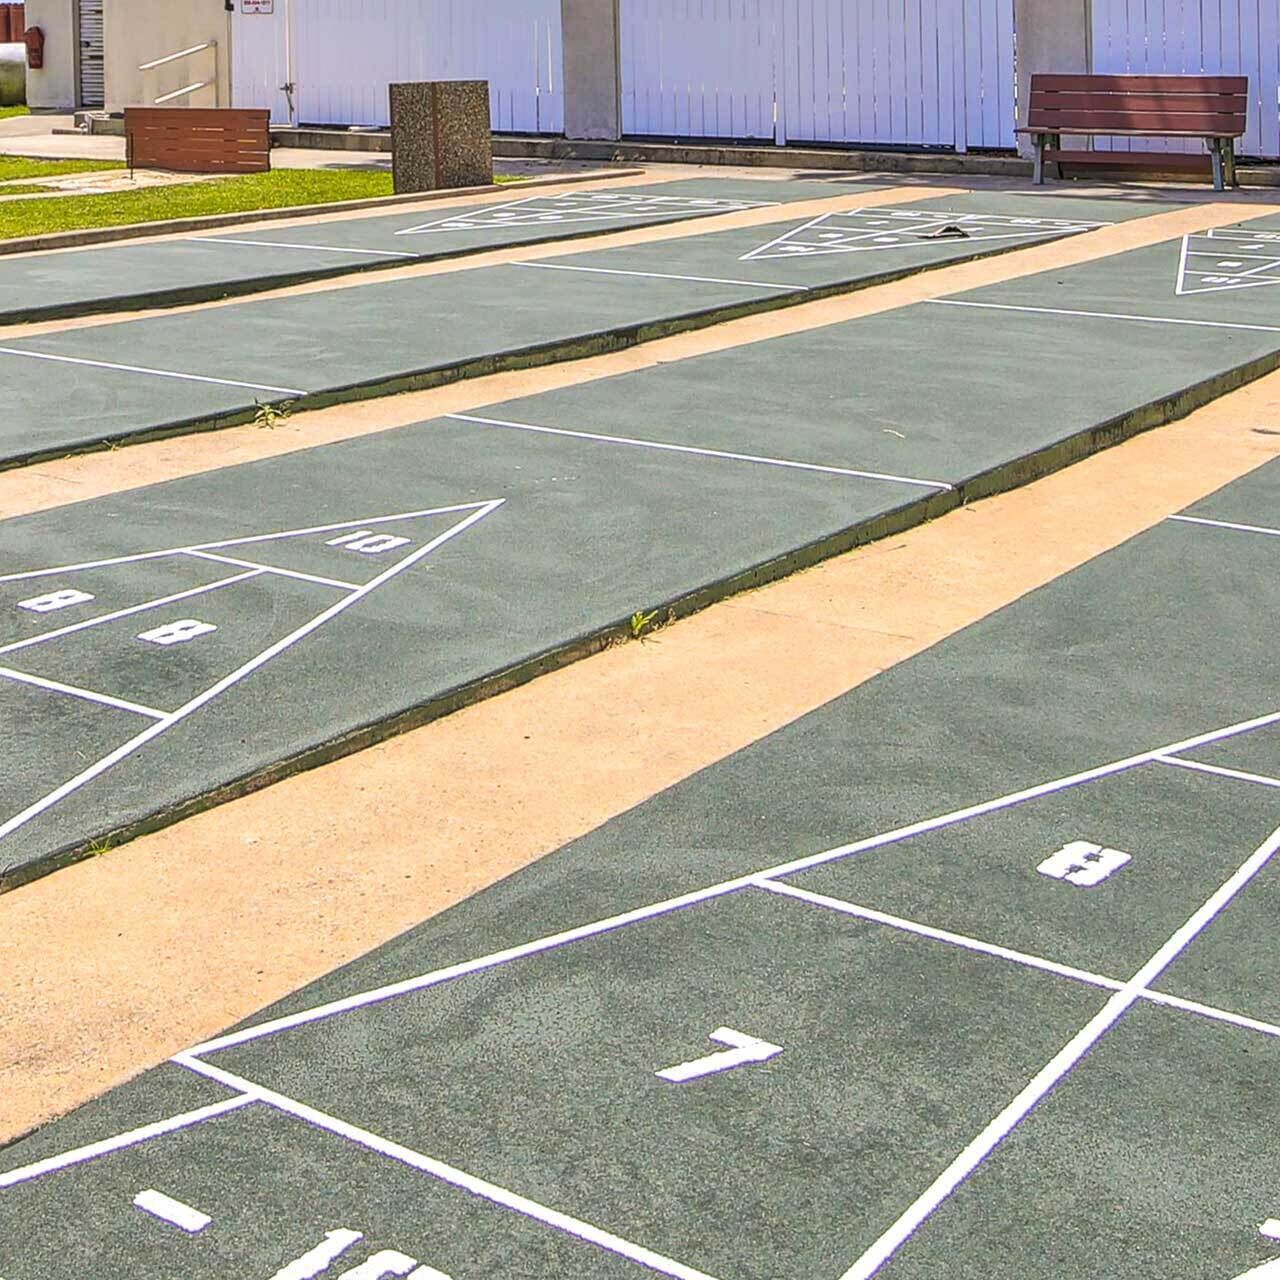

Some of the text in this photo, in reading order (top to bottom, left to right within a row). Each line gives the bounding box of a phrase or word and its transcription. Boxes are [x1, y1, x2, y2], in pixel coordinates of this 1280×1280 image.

[325, 530, 412, 554] 10
[17, 589, 96, 613] 8
[137, 619, 218, 645] 8
[1036, 840, 1133, 888] 8
